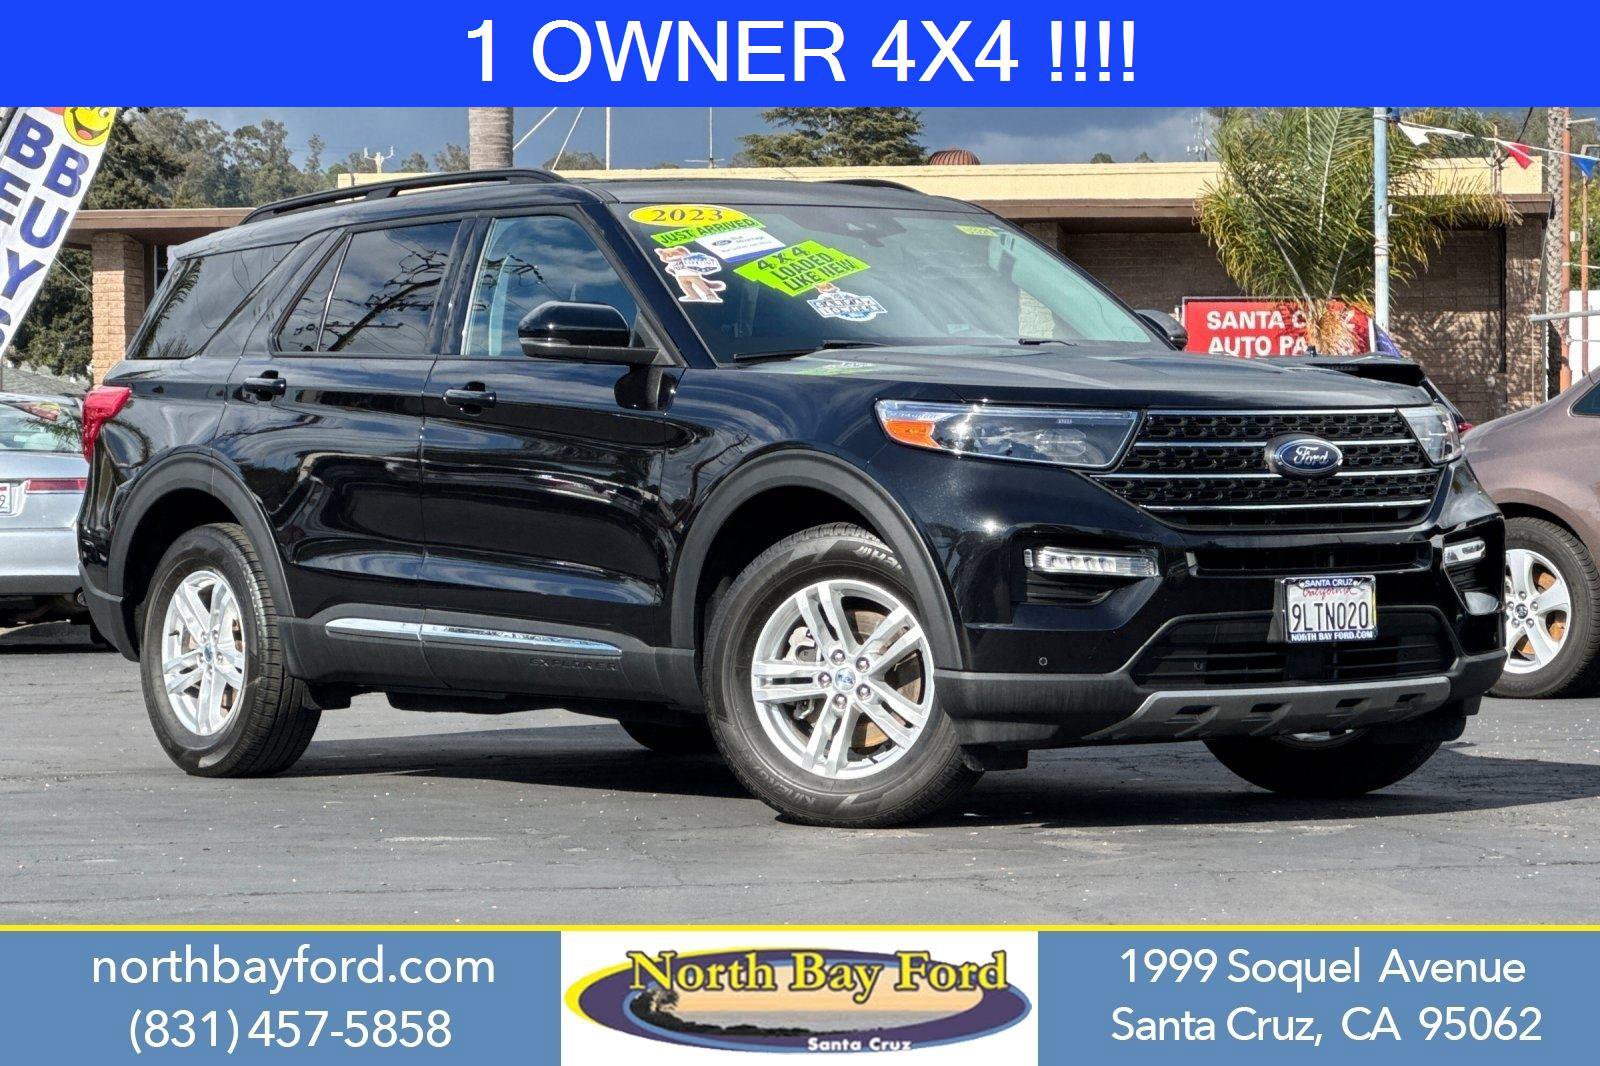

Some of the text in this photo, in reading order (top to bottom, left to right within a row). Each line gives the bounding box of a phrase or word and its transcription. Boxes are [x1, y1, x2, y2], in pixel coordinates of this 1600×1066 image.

[650, 207, 724, 223] 2023
[659, 226, 697, 244] JUST
[698, 216, 758, 237] ARRIVED
[756, 257, 776, 272] 4
[791, 244, 810, 258] 4
[771, 252, 833, 281] LOADED
[781, 258, 856, 292] LIKE NEW
[1206, 310, 1356, 331] SANTA CZ
[1208, 336, 1273, 356] AUTO
[1293, 445, 1330, 466] Ford
[1304, 579, 1354, 588] SANTA CRUZ
[1291, 601, 1369, 632] 9LTN020
[1291, 631, 1374, 642] NORTH BAY FORD.COM
